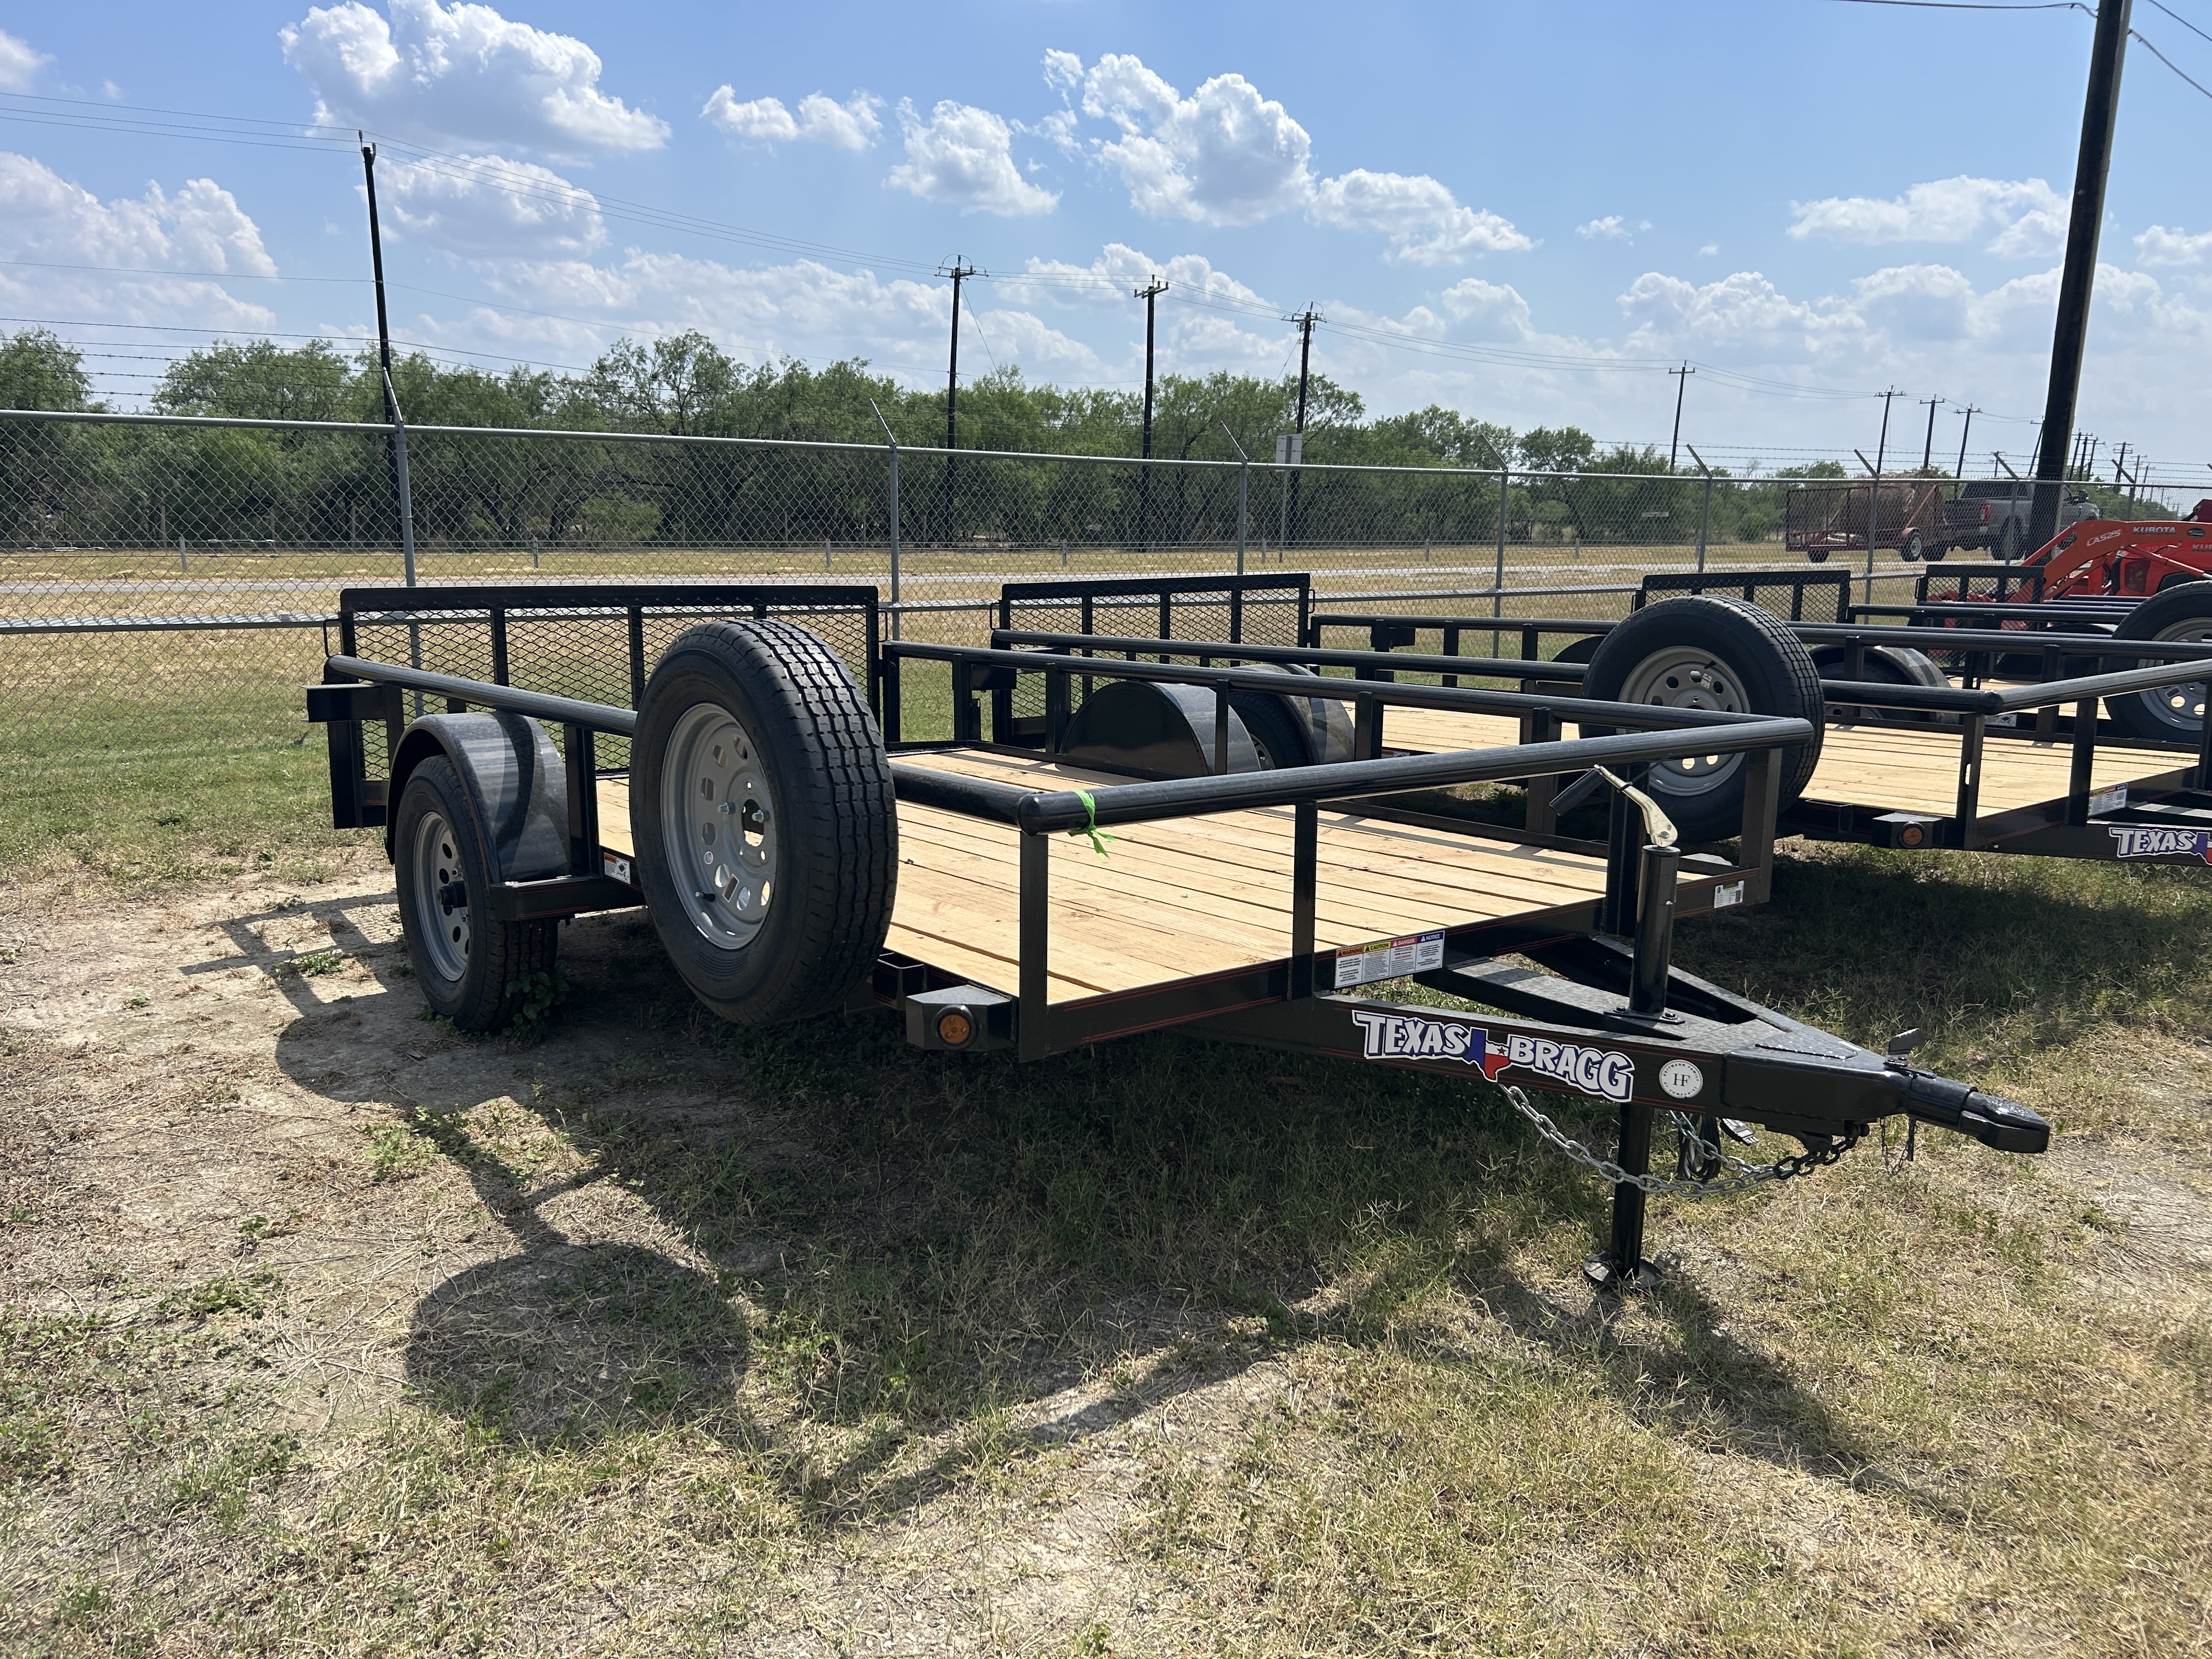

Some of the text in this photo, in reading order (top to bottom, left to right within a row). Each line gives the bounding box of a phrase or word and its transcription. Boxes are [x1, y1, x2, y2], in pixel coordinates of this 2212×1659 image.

[2087, 529, 2122, 546] LA525
[2110, 828, 2196, 856] TEXAS
[1342, 947, 1362, 956] WARNING
[1353, 1012, 1634, 1099] TEXAS BRAGG
